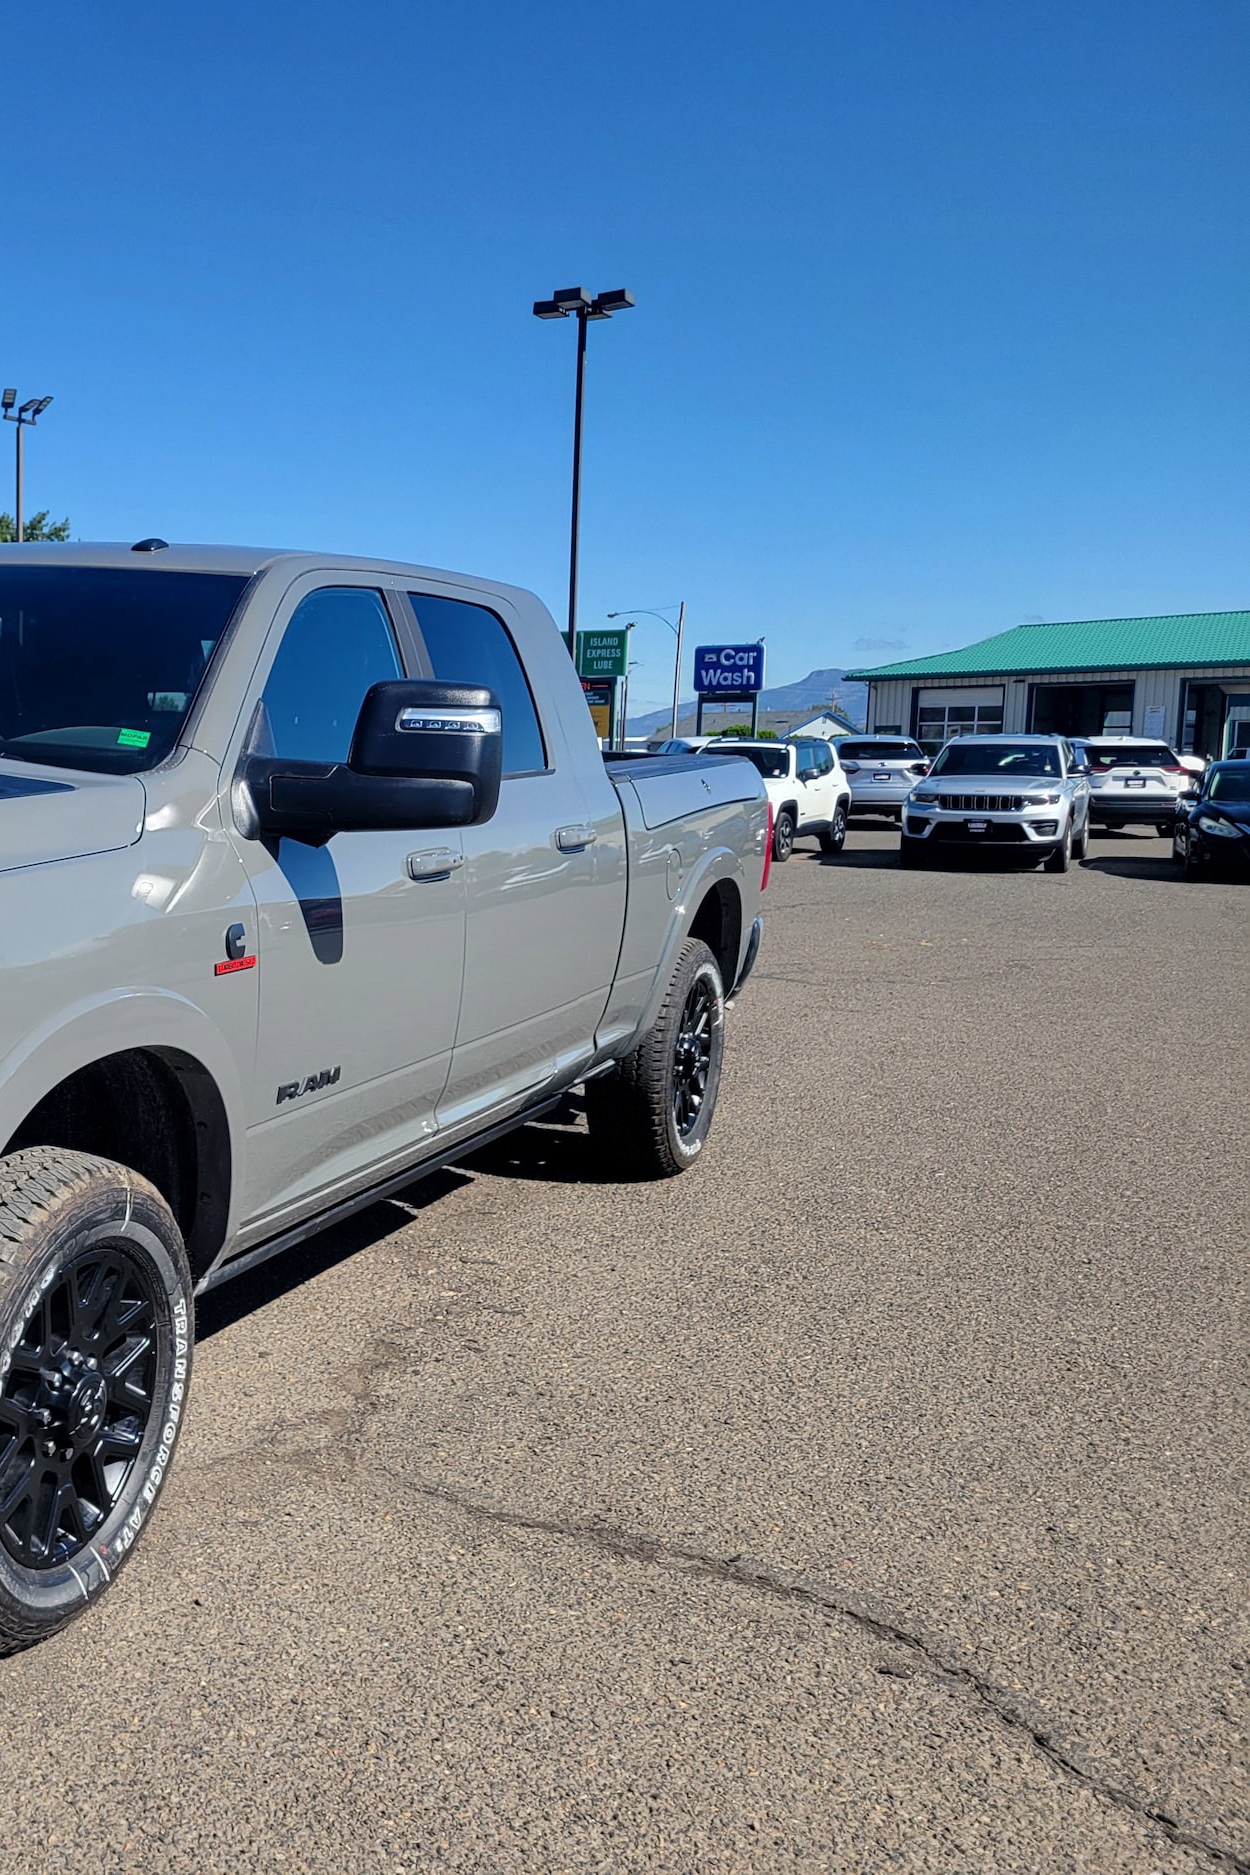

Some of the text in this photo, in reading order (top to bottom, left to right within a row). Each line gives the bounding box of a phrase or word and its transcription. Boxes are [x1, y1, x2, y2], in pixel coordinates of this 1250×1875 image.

[590, 637, 619, 647] ISLAND
[586, 649, 621, 658] EXPRESS
[720, 648, 757, 666] Car
[593, 660, 613, 669] LUBE
[700, 668, 755, 686] Wash
[276, 1065, 342, 1105] RAM
[142, 1299, 188, 1505] TRANSFORCE
